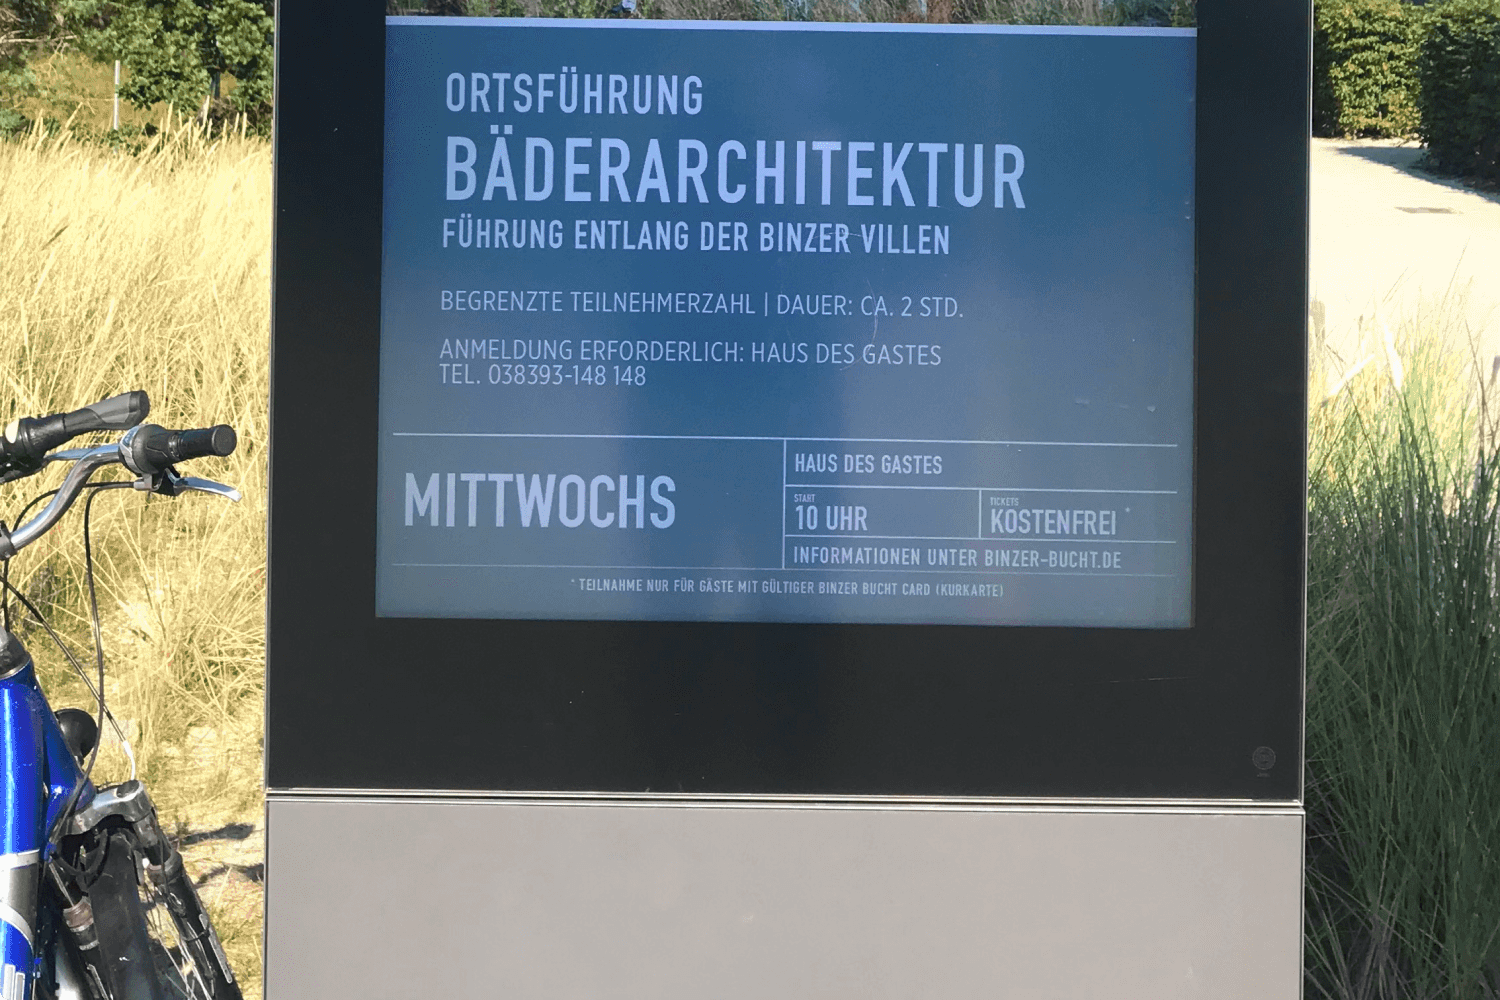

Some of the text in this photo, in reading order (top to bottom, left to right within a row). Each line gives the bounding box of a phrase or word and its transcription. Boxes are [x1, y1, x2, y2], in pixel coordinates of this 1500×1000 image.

[446, 66, 702, 115] ORTSFÜHRUNG
[446, 124, 1026, 208] BÄDERARCHITEKTUR
[443, 214, 950, 254] FÜHRUNG ENTLANG DER BINZER VILLEN
[441, 291, 562, 312] BEGRENZTE
[570, 292, 756, 315] TEILNEHMERZAHL
[777, 295, 853, 316] DAUER:
[860, 296, 894, 317] CA.
[901, 296, 912, 317] 2
[919, 297, 964, 318] STD.
[440, 339, 941, 366] ANMELDUNG ERFORDERLICH: HAUS DES GASTES
[440, 364, 646, 386] TEL. 038393-148 148
[795, 453, 943, 474] HAUS DES GASTES
[404, 471, 676, 530] MITTWOCHS
[794, 494, 815, 502] START
[990, 497, 1019, 506] TICKETS
[795, 505, 868, 531] 10 UHR
[793, 546, 1122, 569] INFORMATIONEN UNTER BINZER-BUCHT.DE
[579, 578, 1004, 597] TEILNAHME NUR FÜR GÄSTE MIT GÜLTIGER BINZER BUCHT CARD (KURKARTE)
